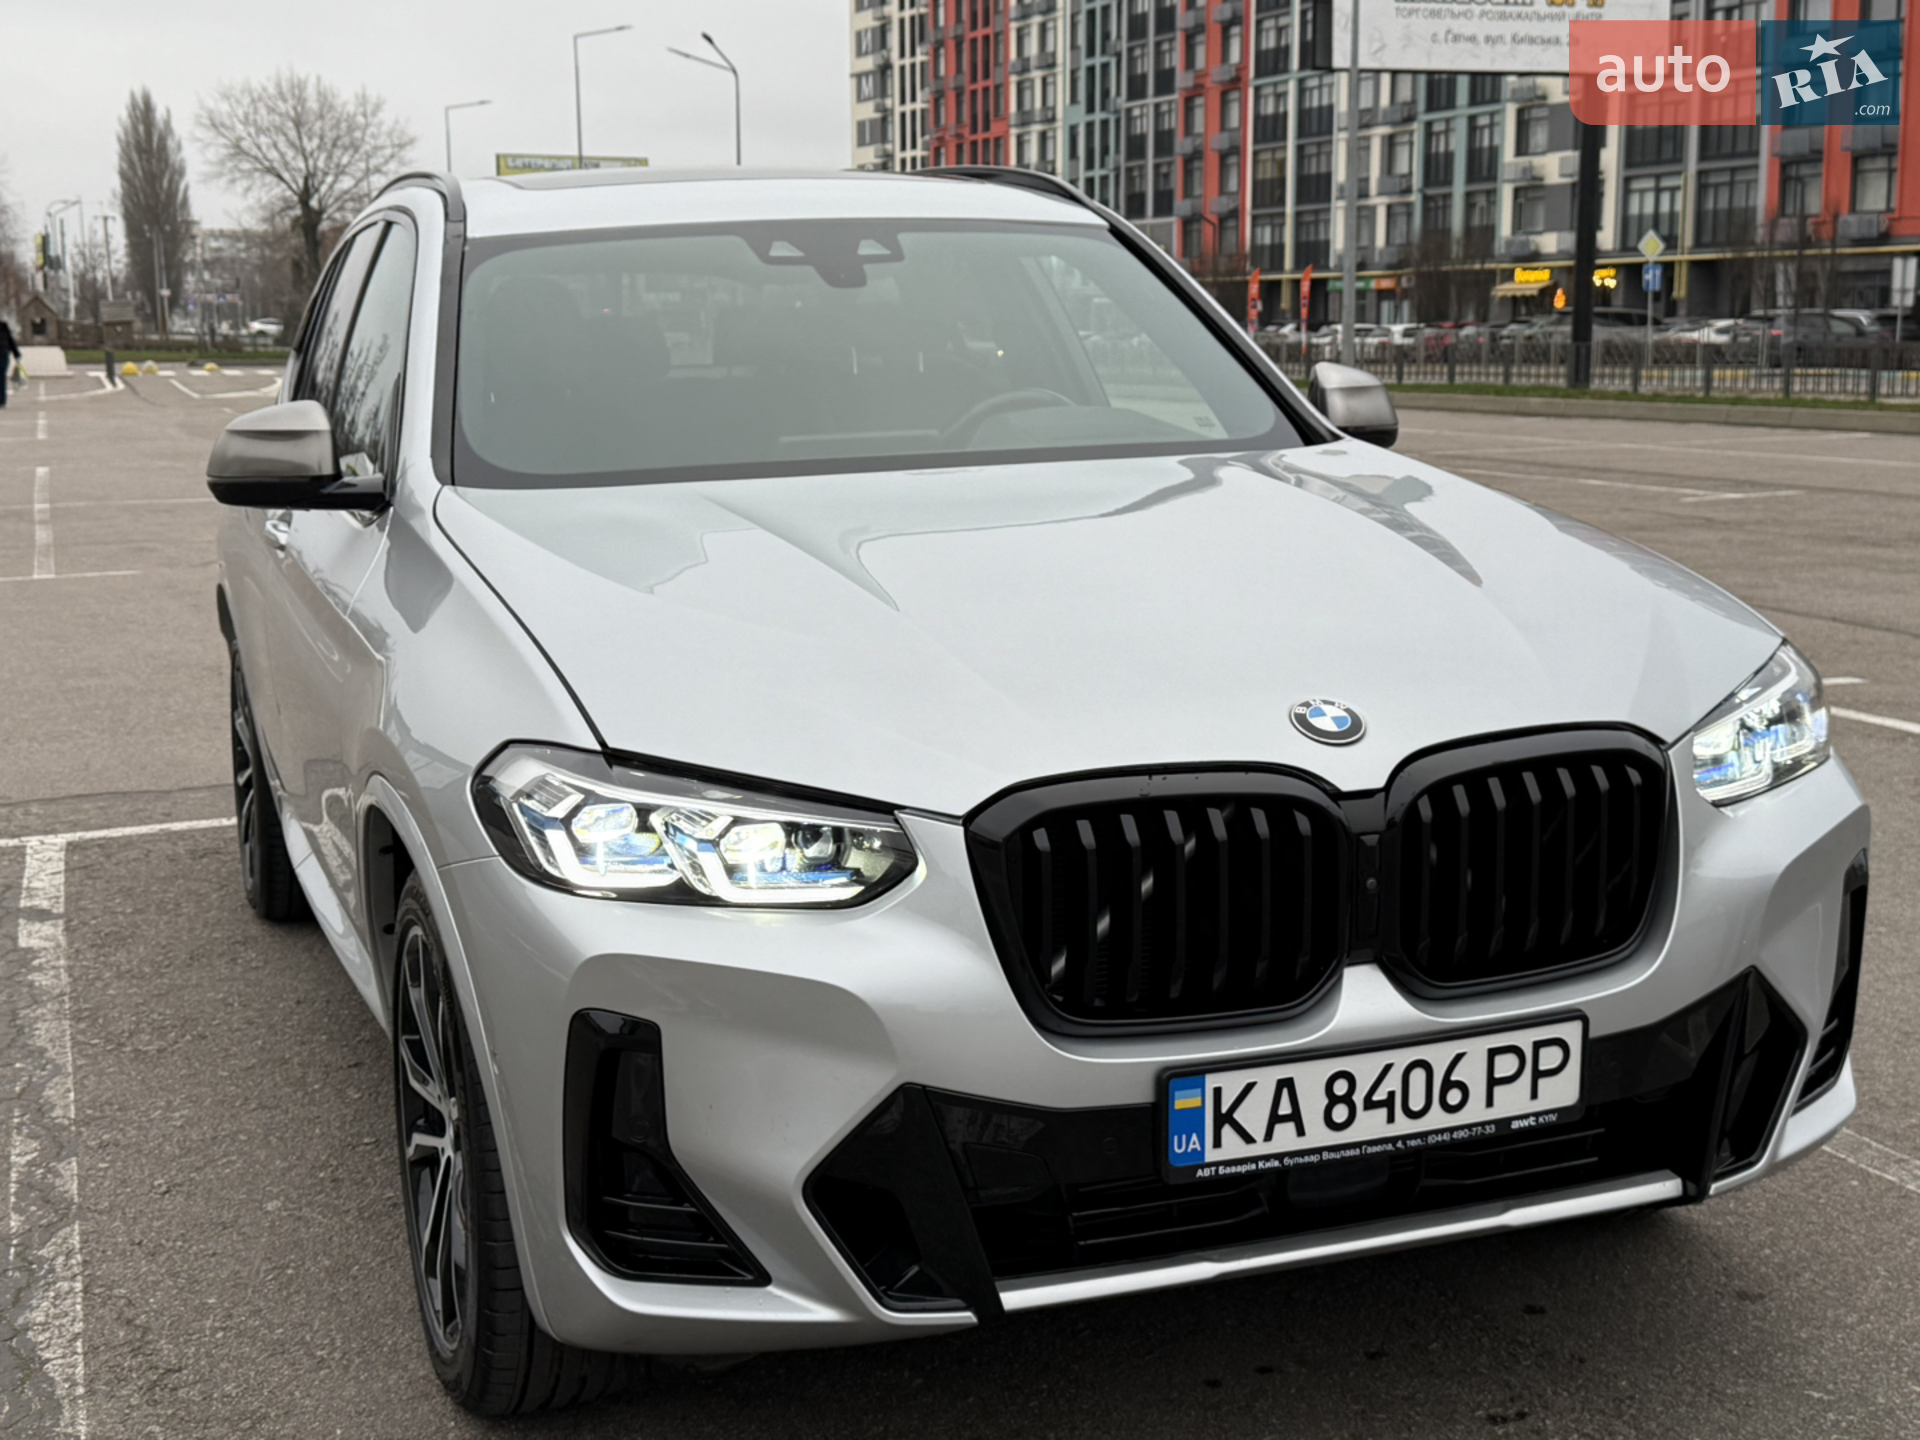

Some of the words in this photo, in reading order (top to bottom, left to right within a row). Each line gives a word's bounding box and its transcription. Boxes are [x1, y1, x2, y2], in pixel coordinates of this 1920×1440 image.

[1212, 1076, 1306, 1149] KA
[1323, 1052, 1470, 1132] 8406
[1485, 1037, 1570, 1108] PP
[1510, 1115, 1537, 1129] awt
[1538, 1112, 1558, 1125] KYIV
[1174, 1132, 1201, 1154] UA
[1195, 1166, 1217, 1178] АВТ
[1218, 1161, 1256, 1175] Баварія
[1258, 1158, 1282, 1170] Київ,
[1283, 1153, 1321, 1167] бульвар
[1322, 1147, 1360, 1160] Вацлава
[1361, 1142, 1395, 1155] Гавела,
[1395, 1139, 1405, 1150] 4,
[1427, 1131, 1450, 1145] (044)
[1451, 1124, 1496, 1140] 490-77-33
